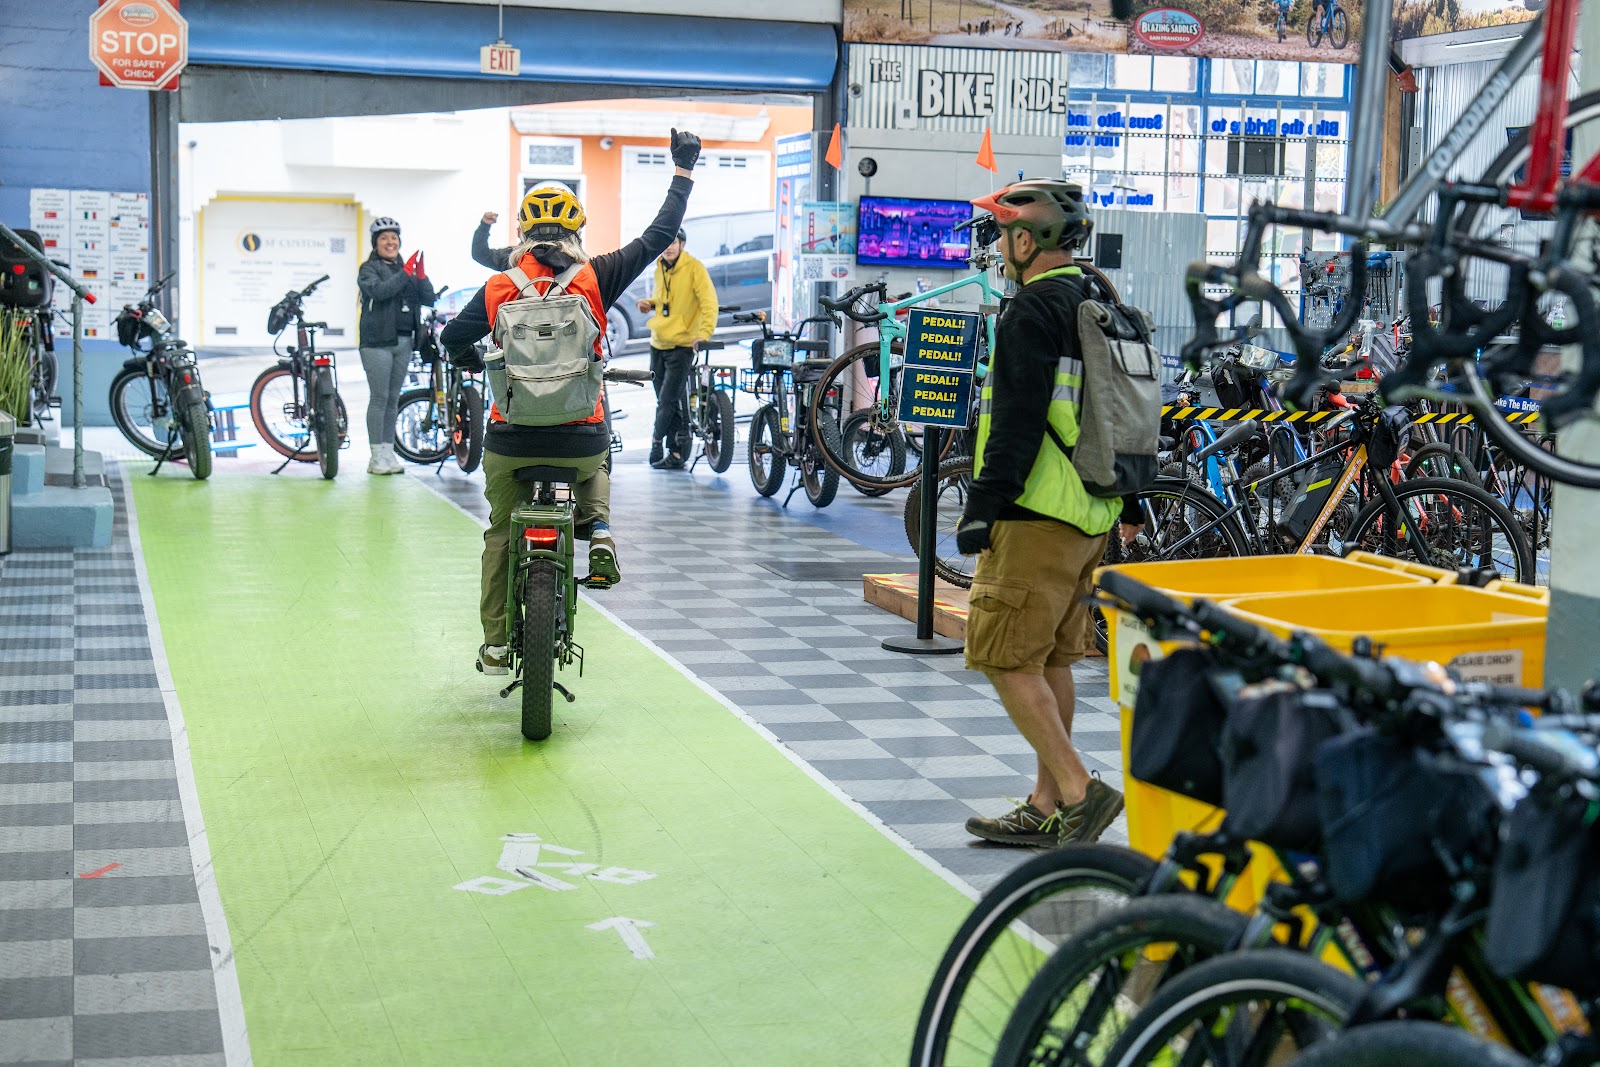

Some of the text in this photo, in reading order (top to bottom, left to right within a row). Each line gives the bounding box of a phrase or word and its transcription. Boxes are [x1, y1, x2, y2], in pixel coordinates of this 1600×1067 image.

[1141, 20, 1198, 36] BLAZING SADDLES
[101, 29, 178, 56] STOP
[112, 58, 166, 69] FOR SAFETY
[490, 48, 516, 71] EXIT
[123, 69, 155, 78] CHECK
[870, 57, 1067, 118] THE BIKE RIDE
[923, 316, 966, 329] PEDAL!!
[921, 333, 964, 345] PEDAL!!
[919, 349, 962, 361] PEDAL!!
[917, 373, 960, 386] PEDAL!!
[914, 390, 957, 402] PEDAL!!
[1509, 399, 1521, 409] The
[912, 406, 955, 418] PEDAL!!
[1332, 456, 1362, 505] SADDLES
